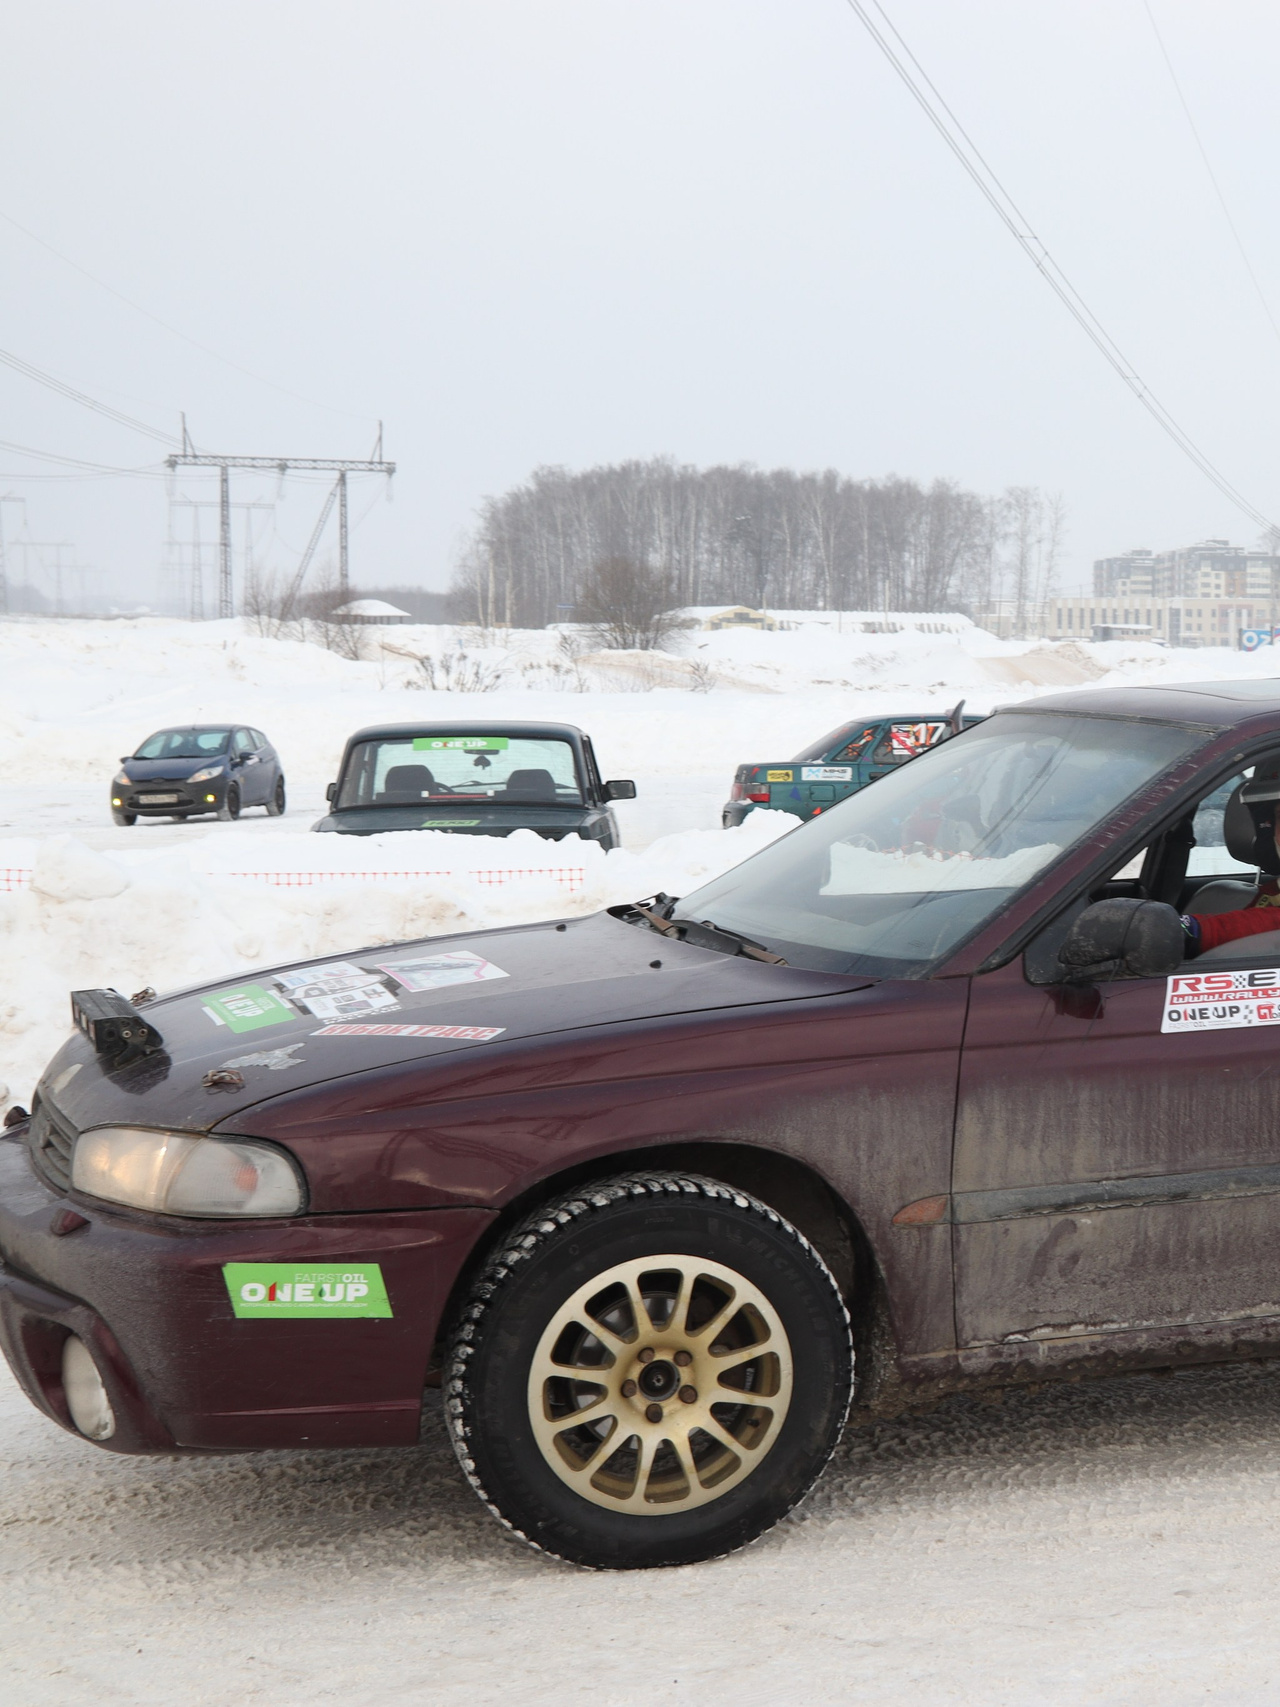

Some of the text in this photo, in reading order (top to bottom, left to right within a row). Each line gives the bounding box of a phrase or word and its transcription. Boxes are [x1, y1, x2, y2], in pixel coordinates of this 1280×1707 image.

[1172, 974, 1234, 993] RS
[1168, 1007, 1210, 1022] ONE
[1212, 1005, 1240, 1019] UP
[322, 1024, 498, 1039] КУБОК ТРАСС
[240, 1282, 369, 1302] ONE UP
